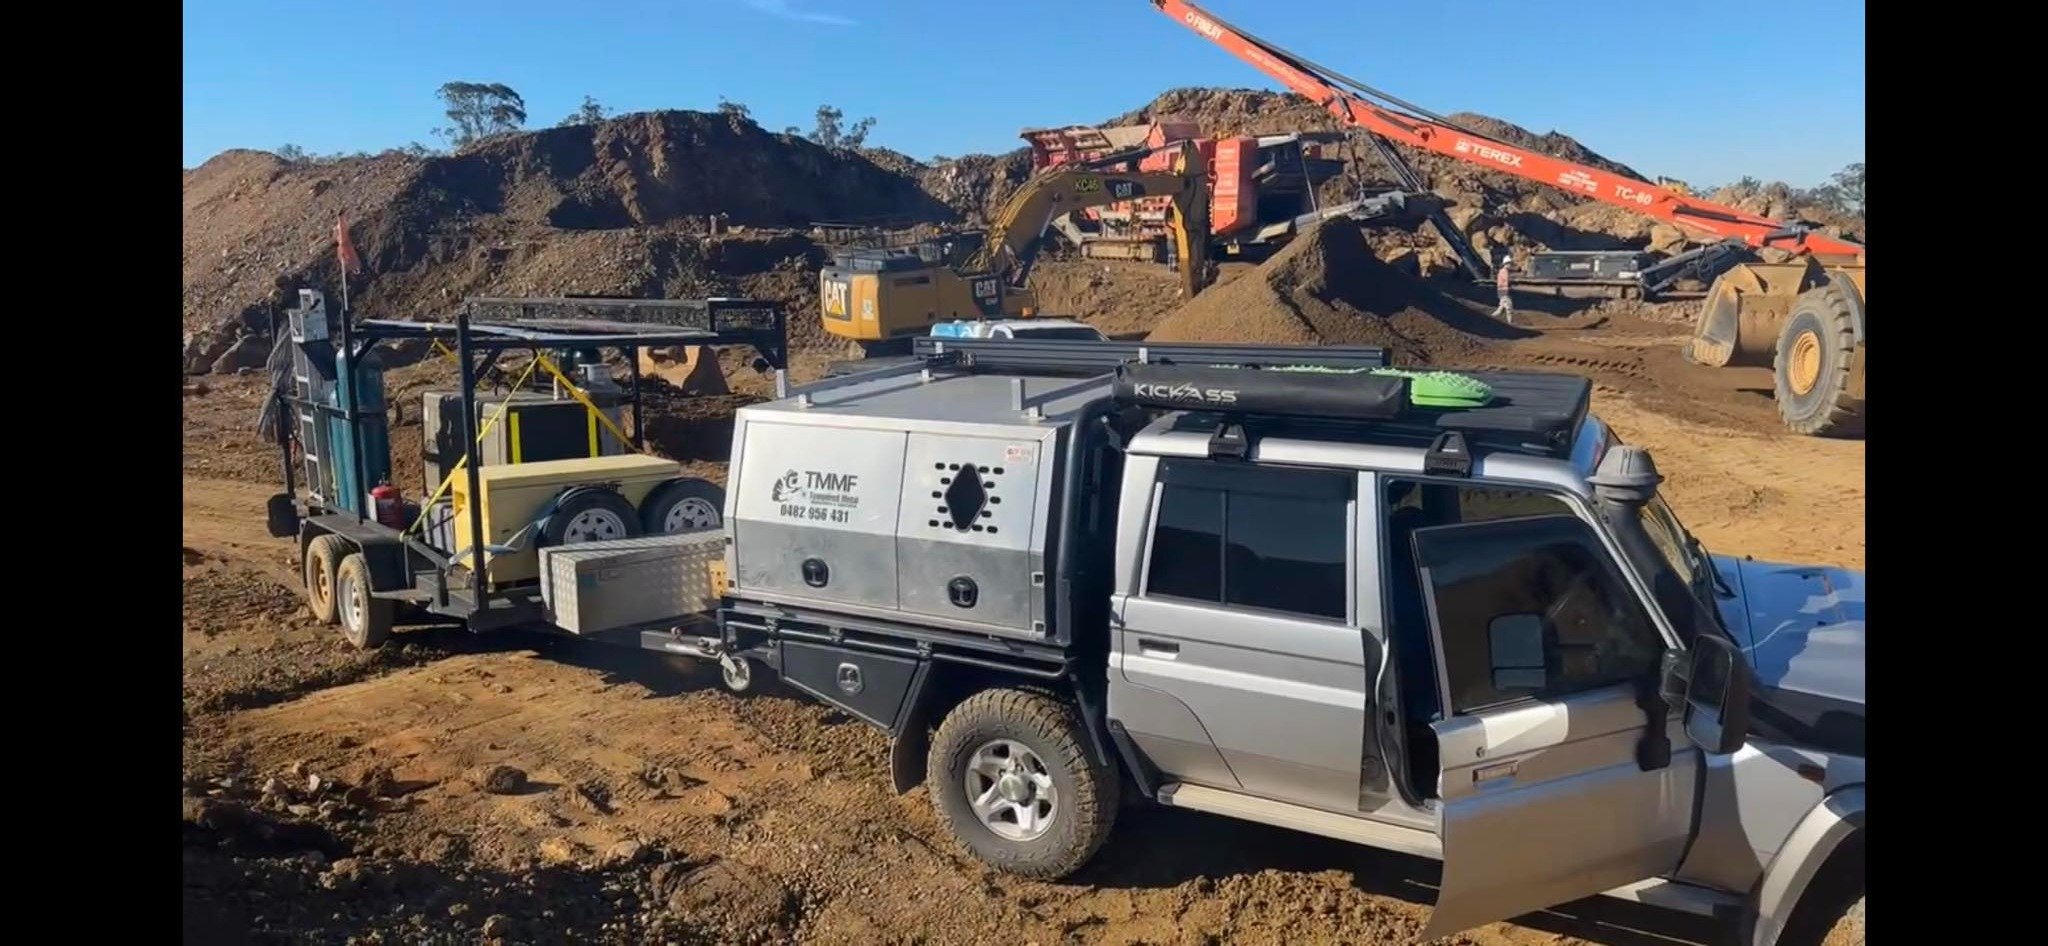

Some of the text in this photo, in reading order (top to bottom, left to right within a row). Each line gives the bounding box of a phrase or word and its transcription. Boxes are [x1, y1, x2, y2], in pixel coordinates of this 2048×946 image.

[1469, 144, 1522, 168] TEREX
[1115, 182, 1133, 198] CAT
[825, 279, 847, 316] CAT
[975, 279, 997, 298] CAT
[805, 471, 858, 492] TMMF
[780, 504, 806, 518] 0482
[808, 506, 828, 521] 956
[830, 508, 849, 523] 431
